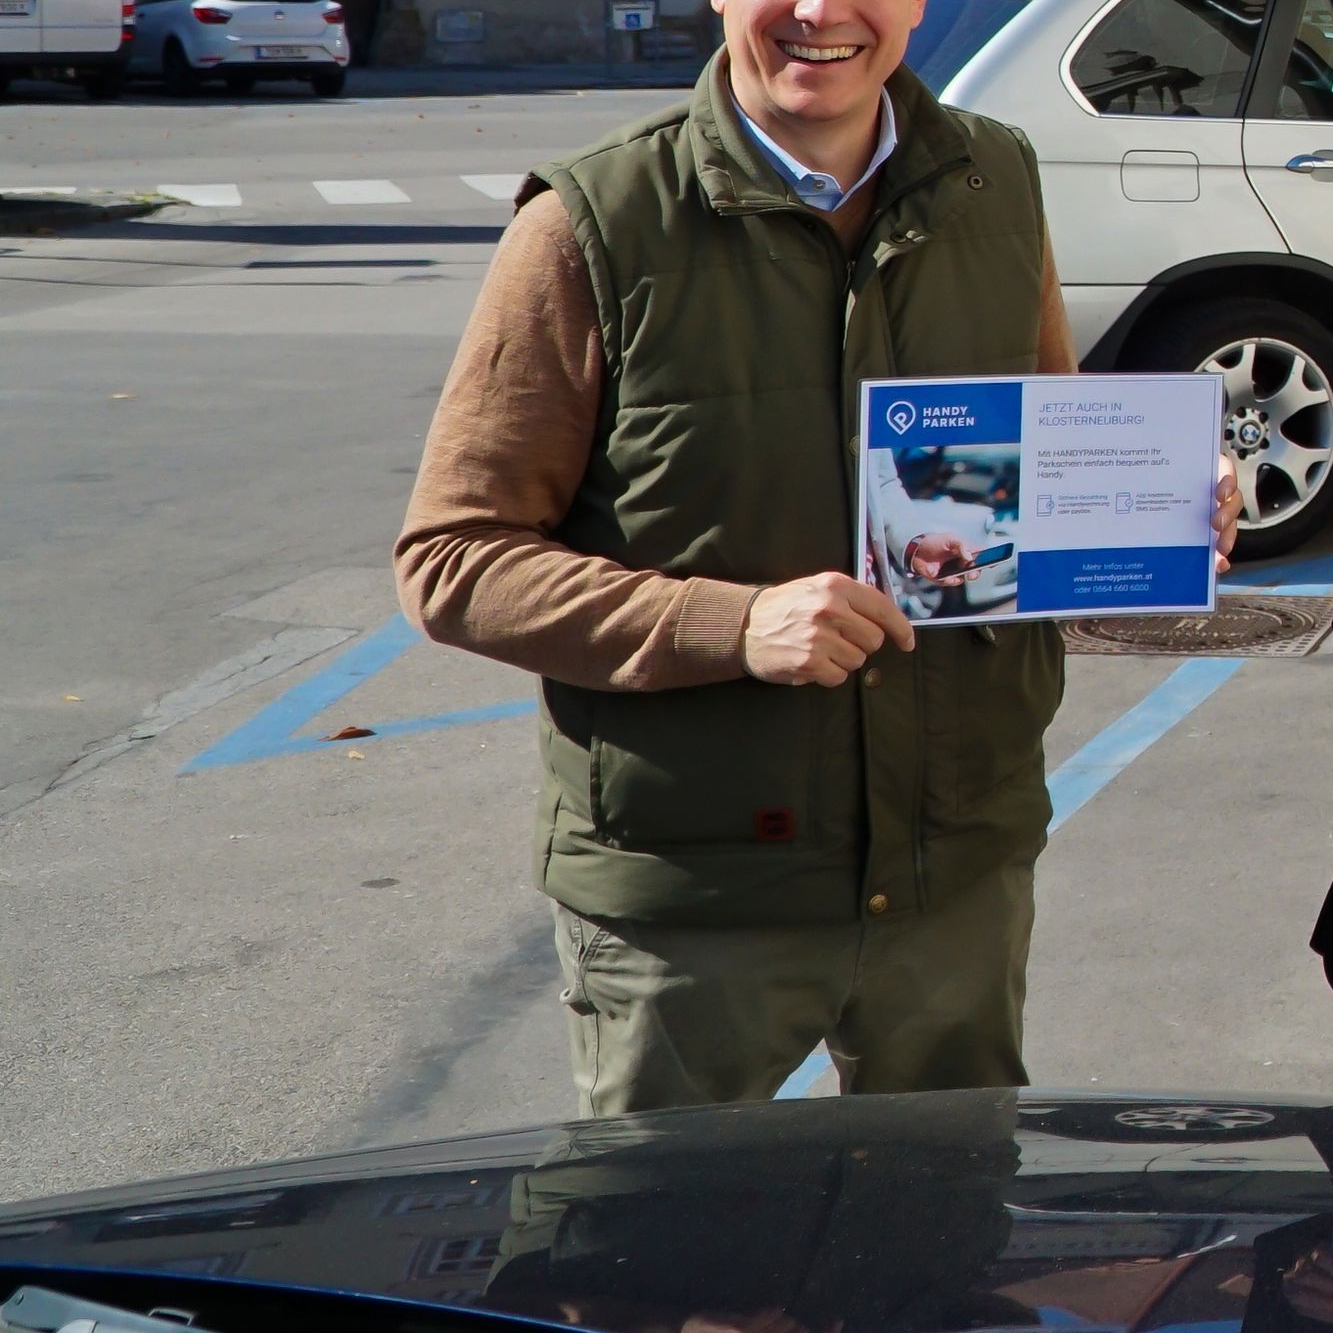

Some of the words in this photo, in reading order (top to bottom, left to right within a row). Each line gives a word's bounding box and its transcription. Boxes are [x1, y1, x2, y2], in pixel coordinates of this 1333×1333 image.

[922, 405, 969, 417] HANDY
[1038, 402, 1074, 413] JETZT
[1075, 402, 1108, 413] AUCH
[1110, 402, 1123, 412] IN
[922, 416, 976, 429] PARKEN
[1038, 415, 1145, 427] KLOSTERNEUBURG!
[1053, 448, 1118, 458] HANDYPARKEN
[1119, 448, 1149, 457] kommt
[1037, 459, 1082, 469] Parkschein
[1084, 458, 1114, 468] einfach
[1116, 458, 1149, 468] bequem
[1073, 573, 1153, 583] www.handyparken.at
